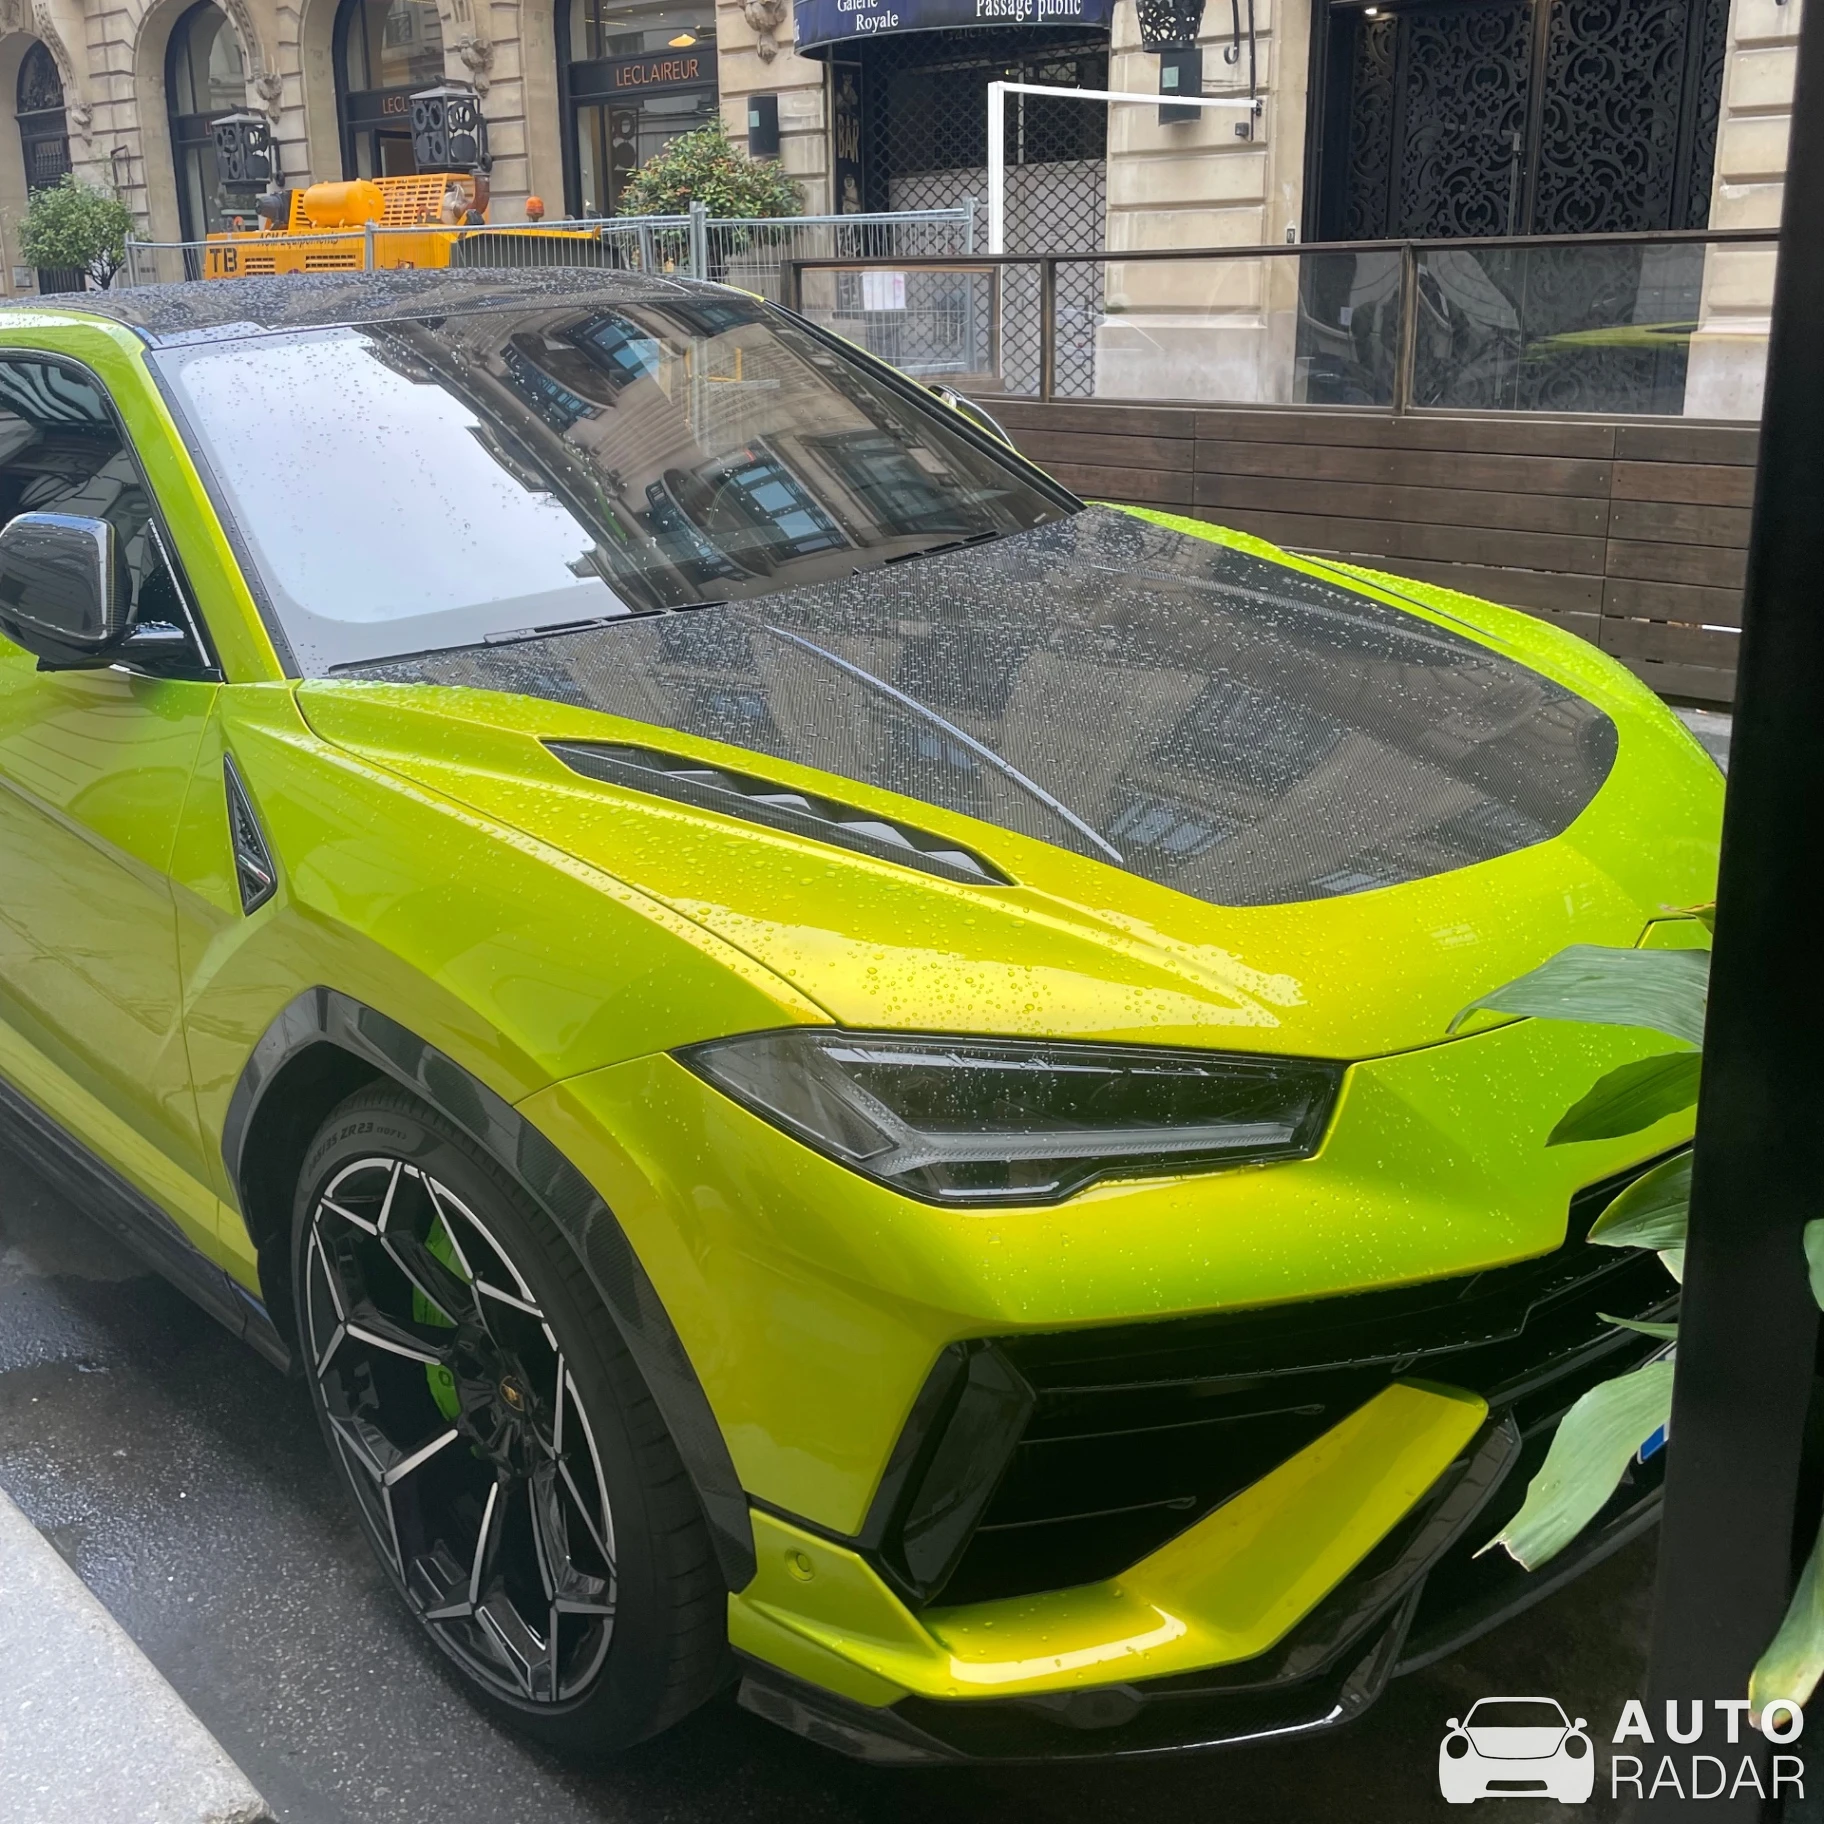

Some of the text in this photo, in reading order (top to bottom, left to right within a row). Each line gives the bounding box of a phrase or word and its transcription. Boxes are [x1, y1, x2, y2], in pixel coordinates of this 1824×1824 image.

[855, 10, 899, 33] Royale
[976, 0, 1082, 22] Passage public
[616, 59, 699, 87] LECLAIREUR
[837, 113, 859, 163] BAR
[209, 248, 238, 272] TB
